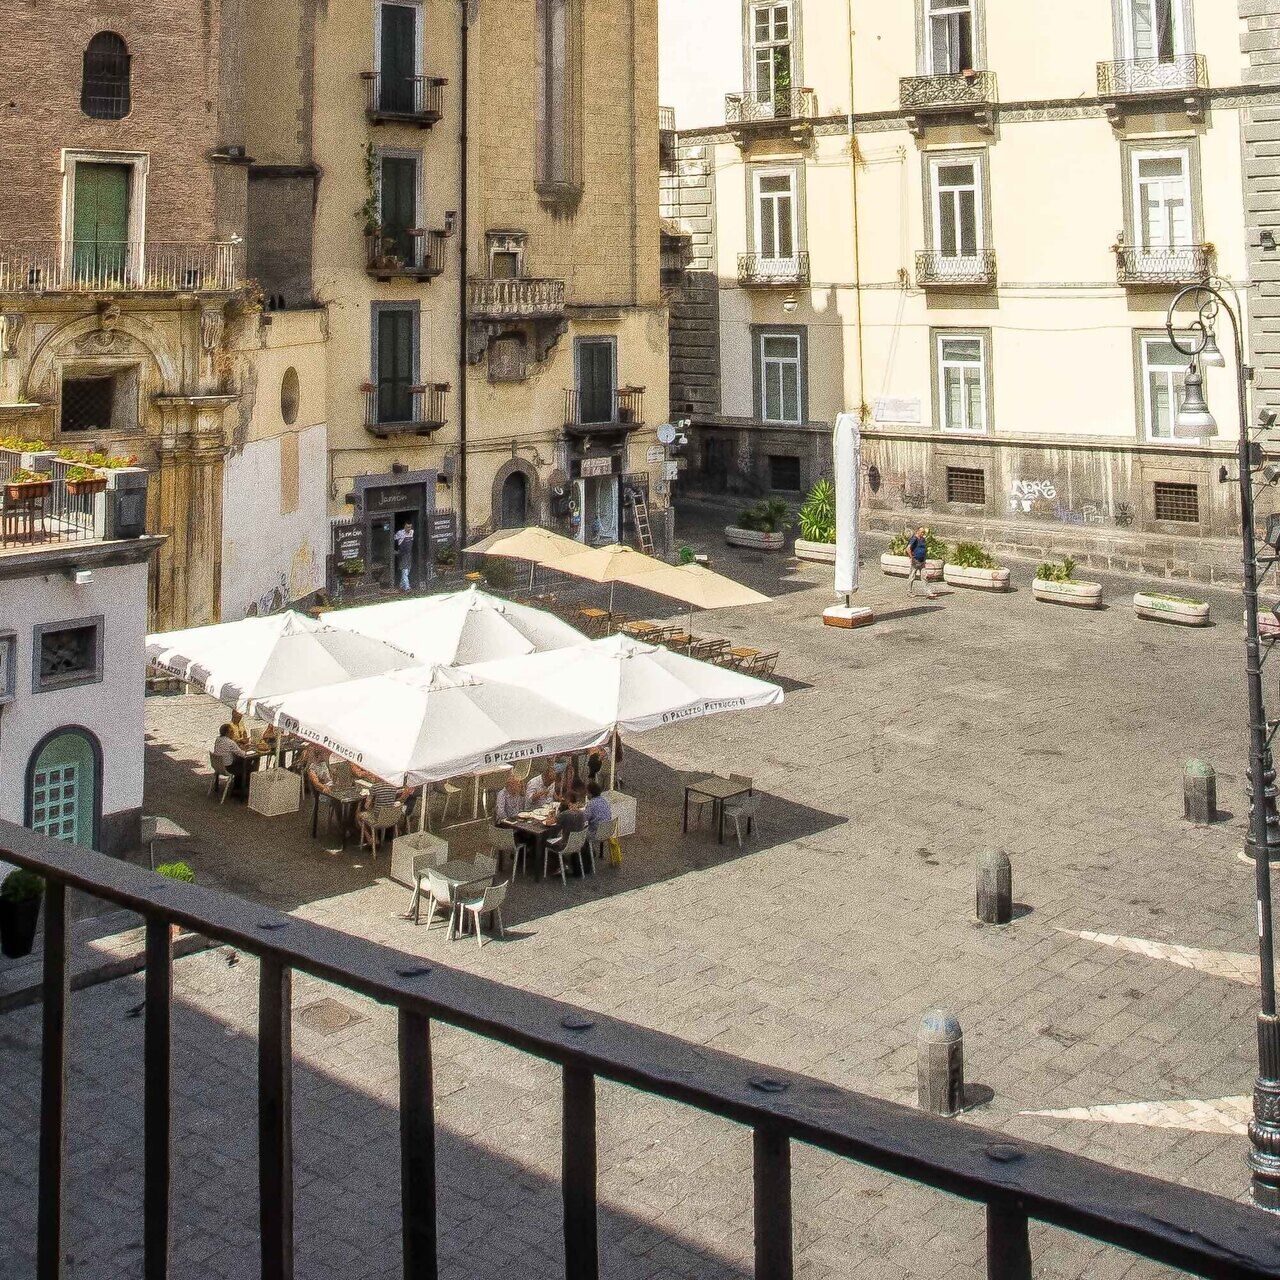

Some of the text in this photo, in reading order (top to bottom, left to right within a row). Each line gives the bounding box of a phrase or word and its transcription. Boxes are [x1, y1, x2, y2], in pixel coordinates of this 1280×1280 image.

[671, 700, 738, 721] PALAZZO PETRUCCI
[292, 721, 356, 759] PALAZZO PETRUCCI
[494, 747, 535, 763] PIZZERIA
